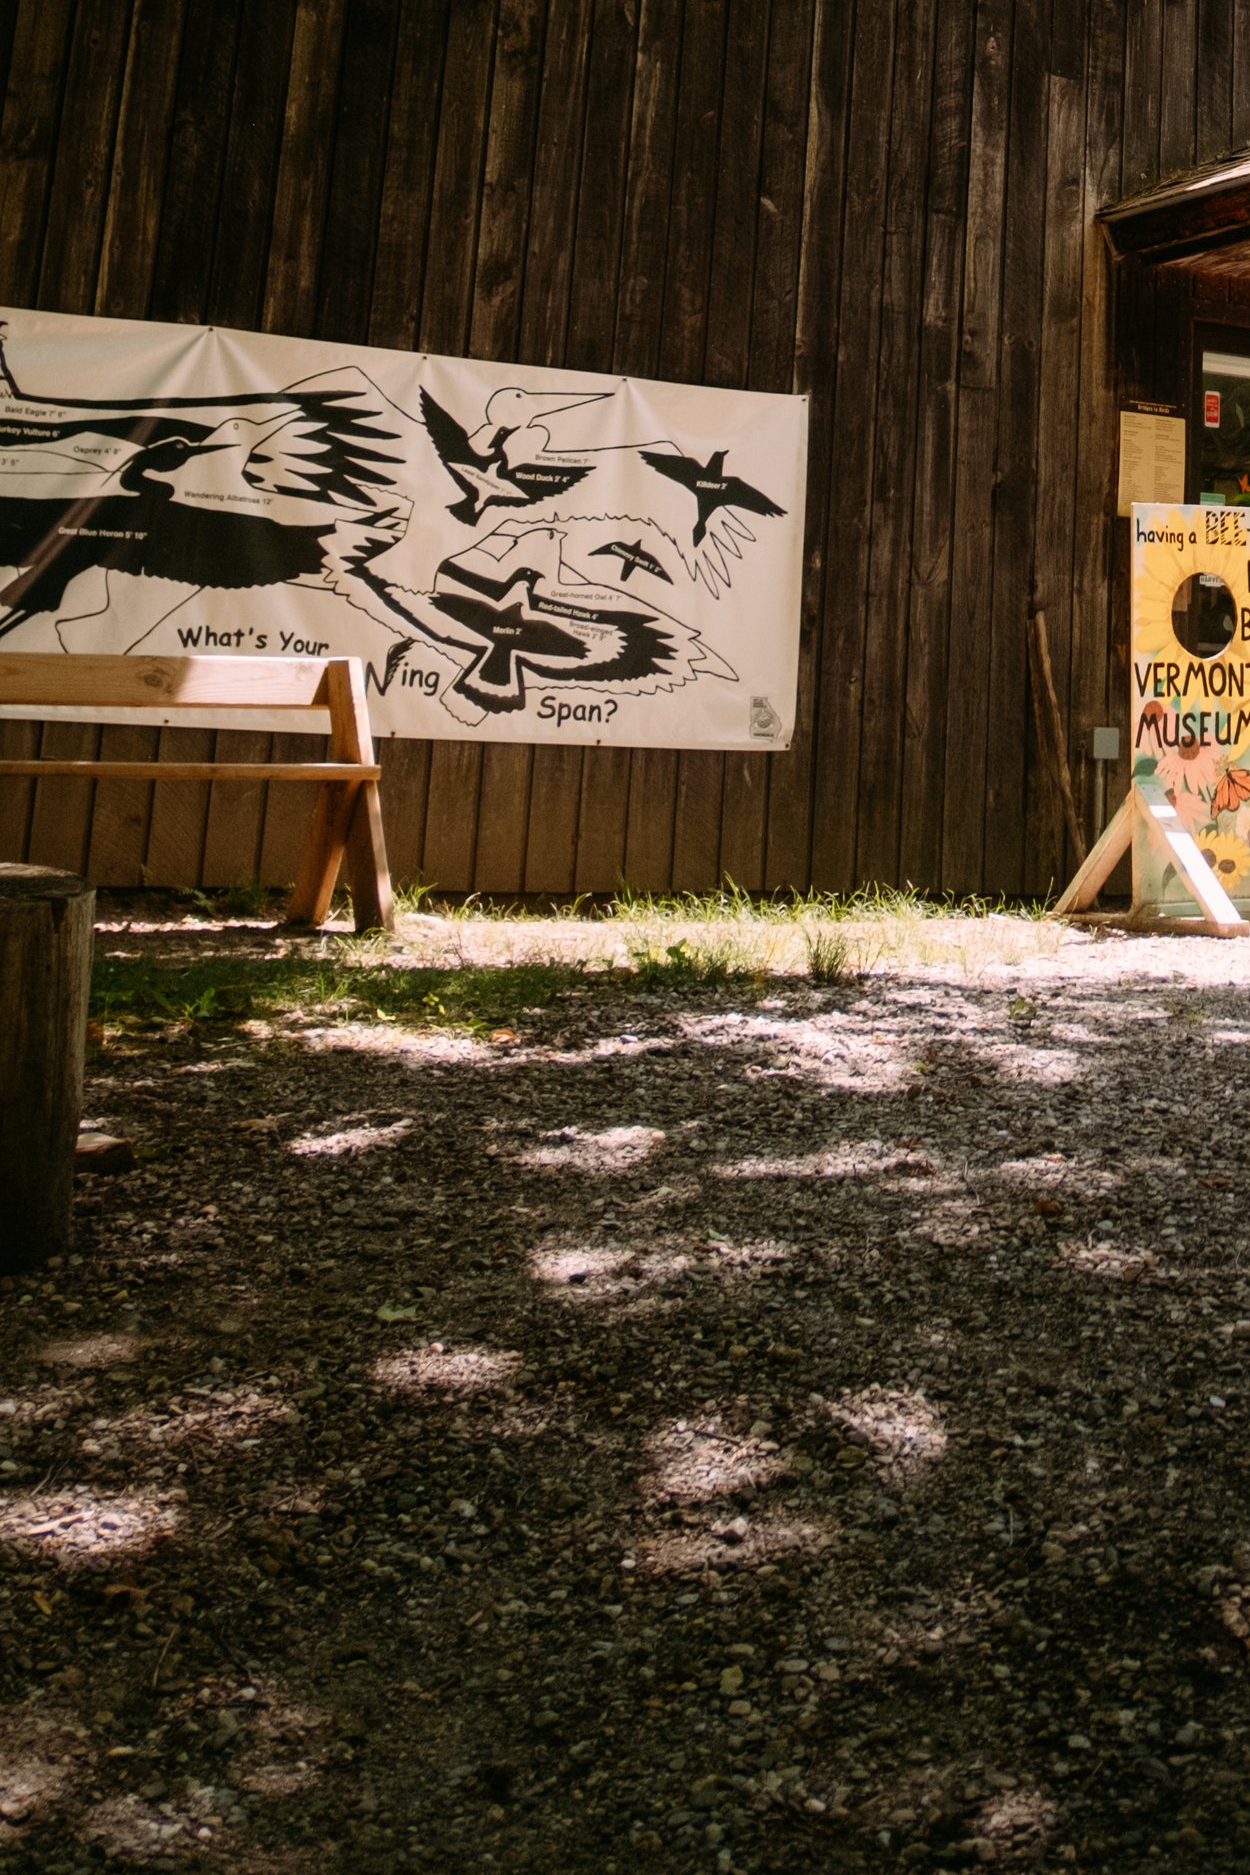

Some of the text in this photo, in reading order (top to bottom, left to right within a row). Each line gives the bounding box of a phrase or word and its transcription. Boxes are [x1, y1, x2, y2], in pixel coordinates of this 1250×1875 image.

[5, 406, 23, 415] Bald
[25, 407, 47, 417] Eagle
[0, 425, 21, 436] urkey
[23, 427, 51, 438] Vulture
[73, 446, 103, 456] Osprey
[515, 471, 536, 481] Wood
[536, 473, 554, 482] Duck
[184, 491, 225, 502] Wandering
[226, 494, 261, 505] Albatross
[58, 526, 78, 536] Great
[79, 528, 98, 537] Blue
[99, 529, 124, 538] Heron
[1136, 518, 1184, 551] having
[1190, 530, 1198, 544] a
[538, 601, 573, 615] Red-tailed
[573, 608, 591, 619] Hawk
[492, 626, 515, 636] Merlin
[178, 625, 330, 657] What's Your
[537, 695, 619, 728] Span?
